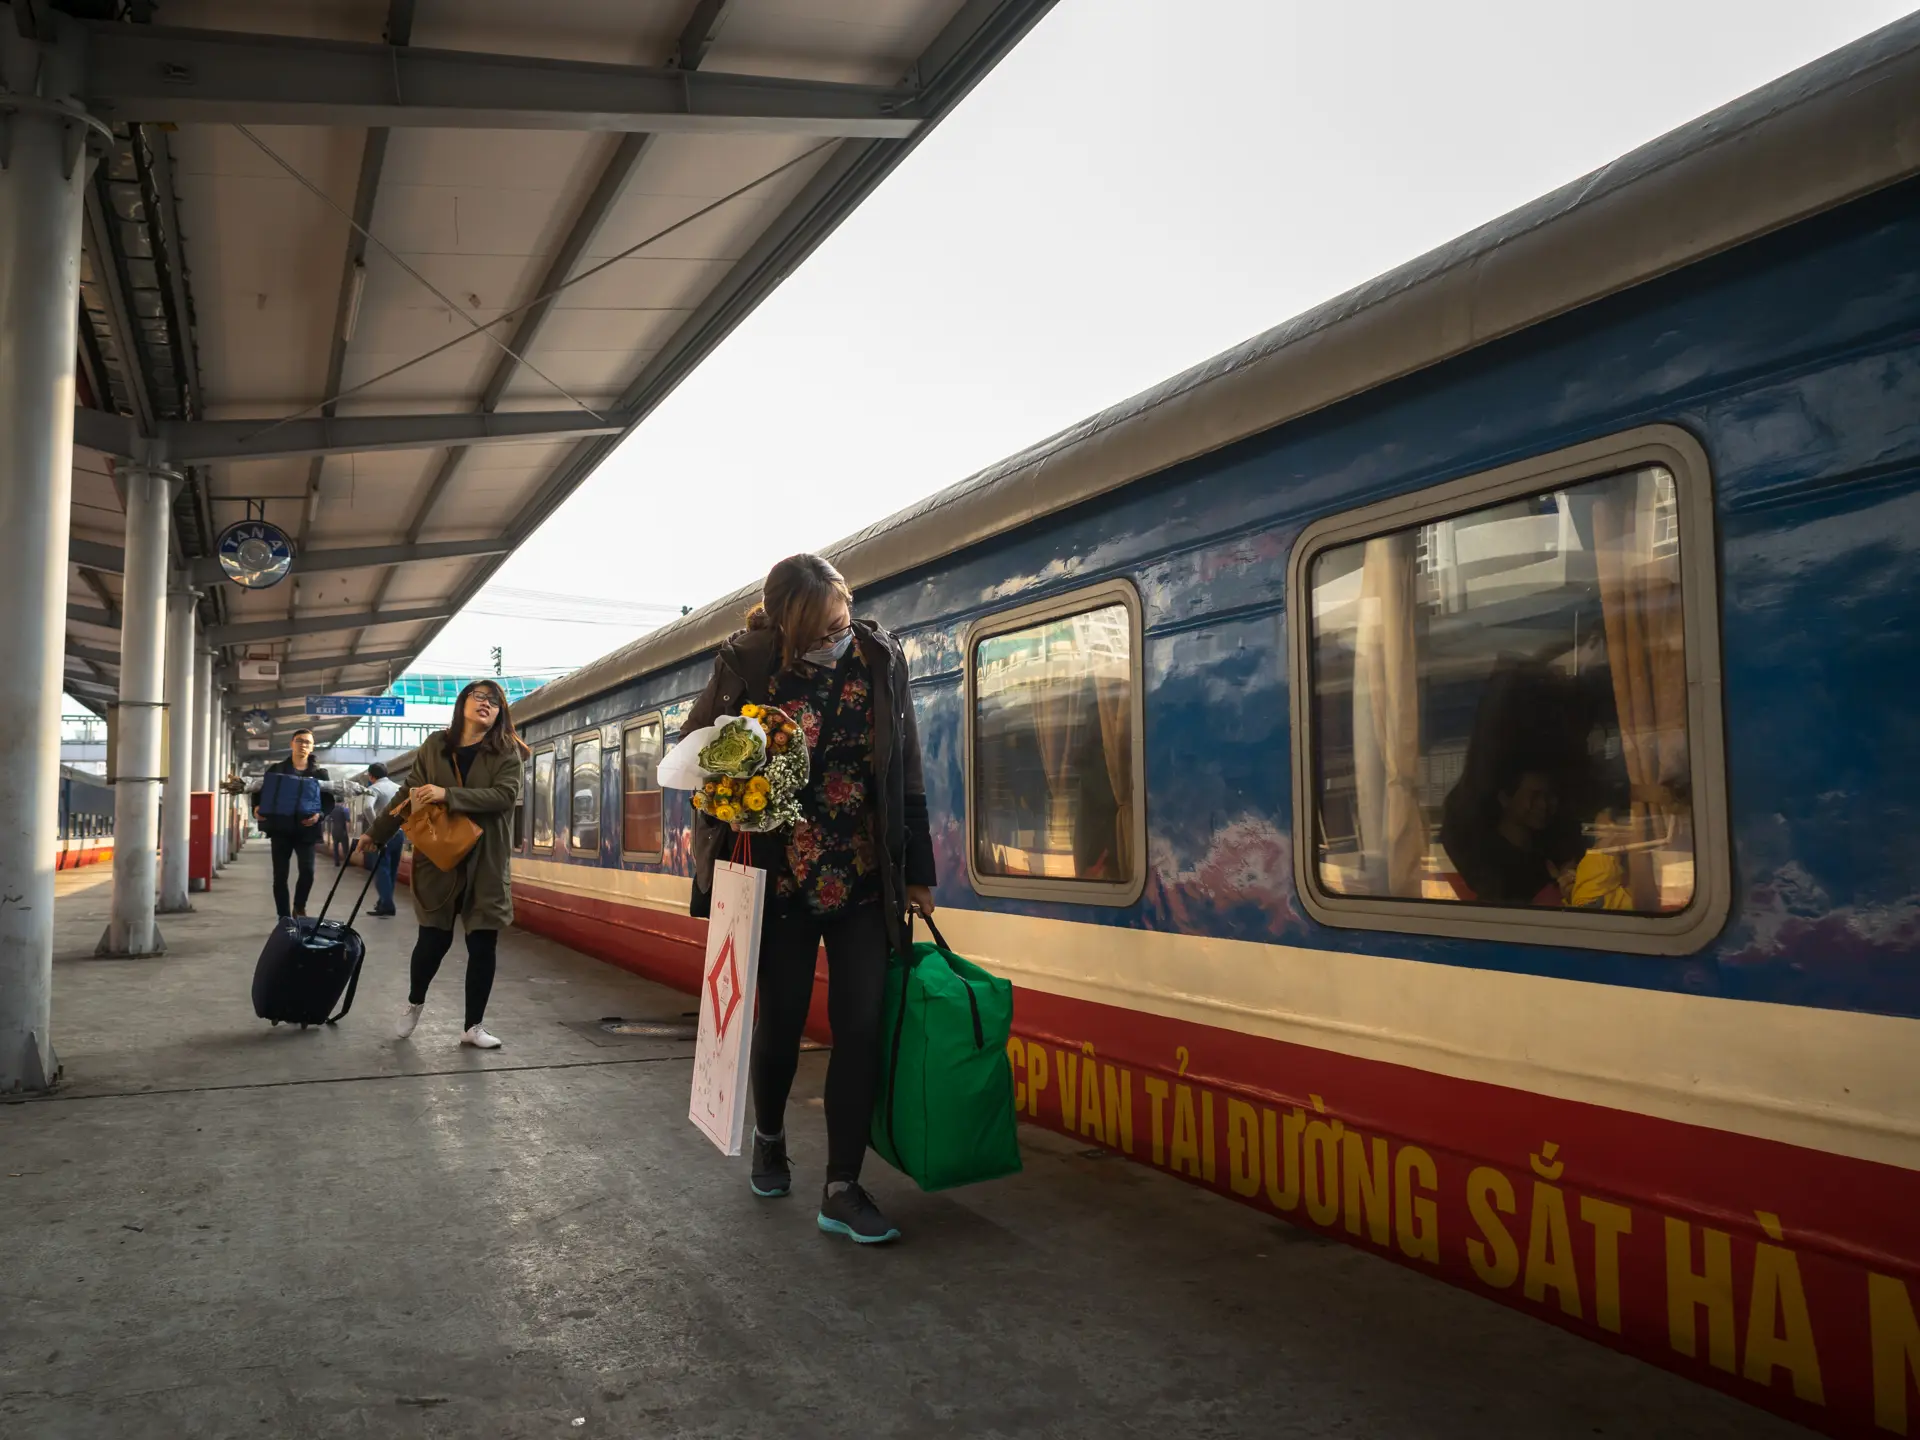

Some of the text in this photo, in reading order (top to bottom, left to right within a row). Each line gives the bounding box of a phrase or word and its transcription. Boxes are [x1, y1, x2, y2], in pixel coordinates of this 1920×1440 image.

[341, 706, 348, 714] 3
[1006, 1036, 1049, 1117] CP
[1144, 1046, 1216, 1184] TẢI
[1227, 1094, 1440, 1265] ĐƯỜNG
[1465, 1140, 1633, 1335] SẮT
[1664, 1210, 1826, 1408] HÀ
